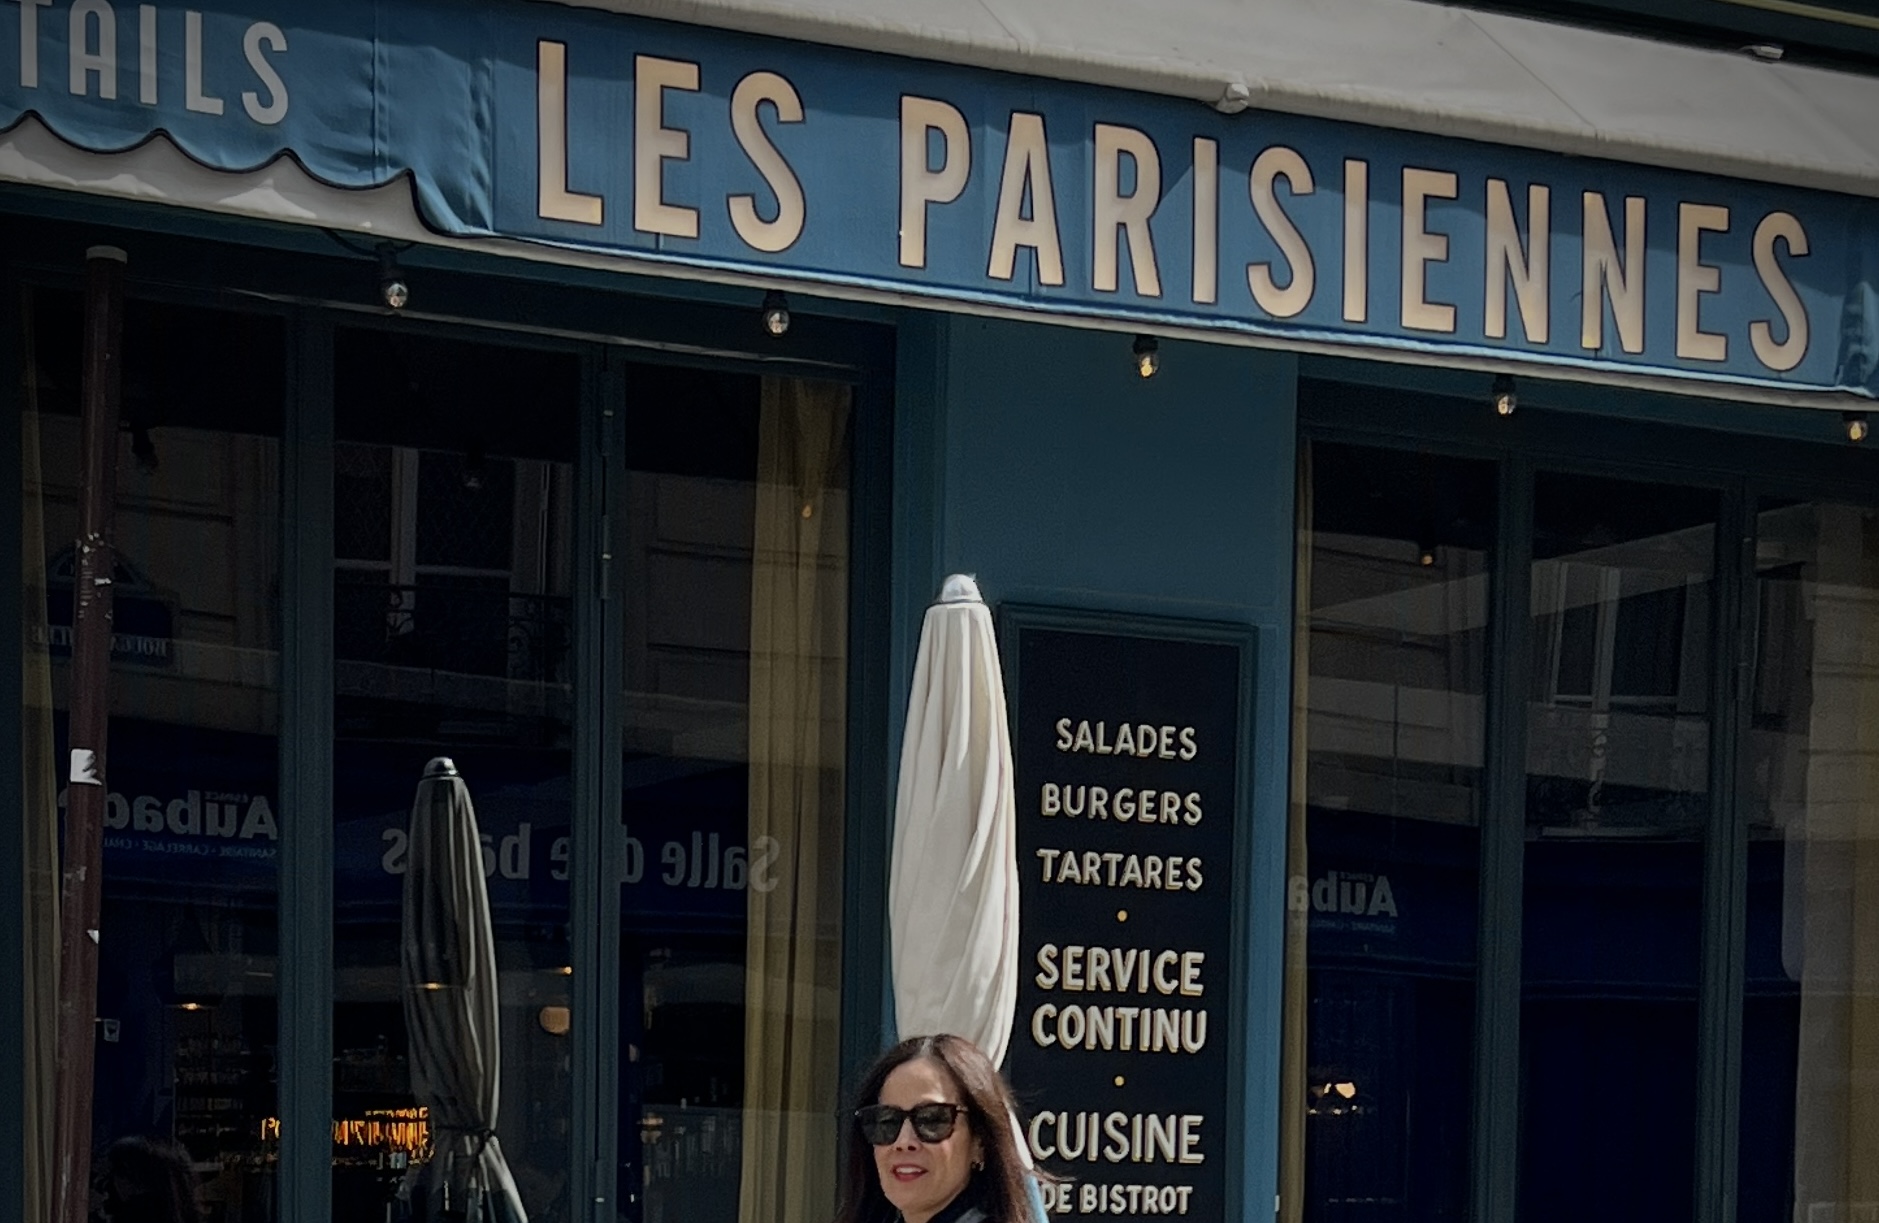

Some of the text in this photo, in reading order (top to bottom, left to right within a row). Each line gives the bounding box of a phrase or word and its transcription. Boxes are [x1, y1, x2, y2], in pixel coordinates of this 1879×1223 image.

[14, 0, 289, 126] TAILS
[536, 39, 1811, 373] LES PARISIENNES
[1056, 718, 1198, 761] SALADES
[1041, 783, 1203, 826] BURGERS
[1036, 848, 1204, 892] TARTARES
[1035, 943, 1206, 997] SERVICE
[1032, 1003, 1208, 1054] CONTINU
[1028, 1110, 1205, 1164] CUISINE
[1042, 1183, 1193, 1215] DE BISTROT
